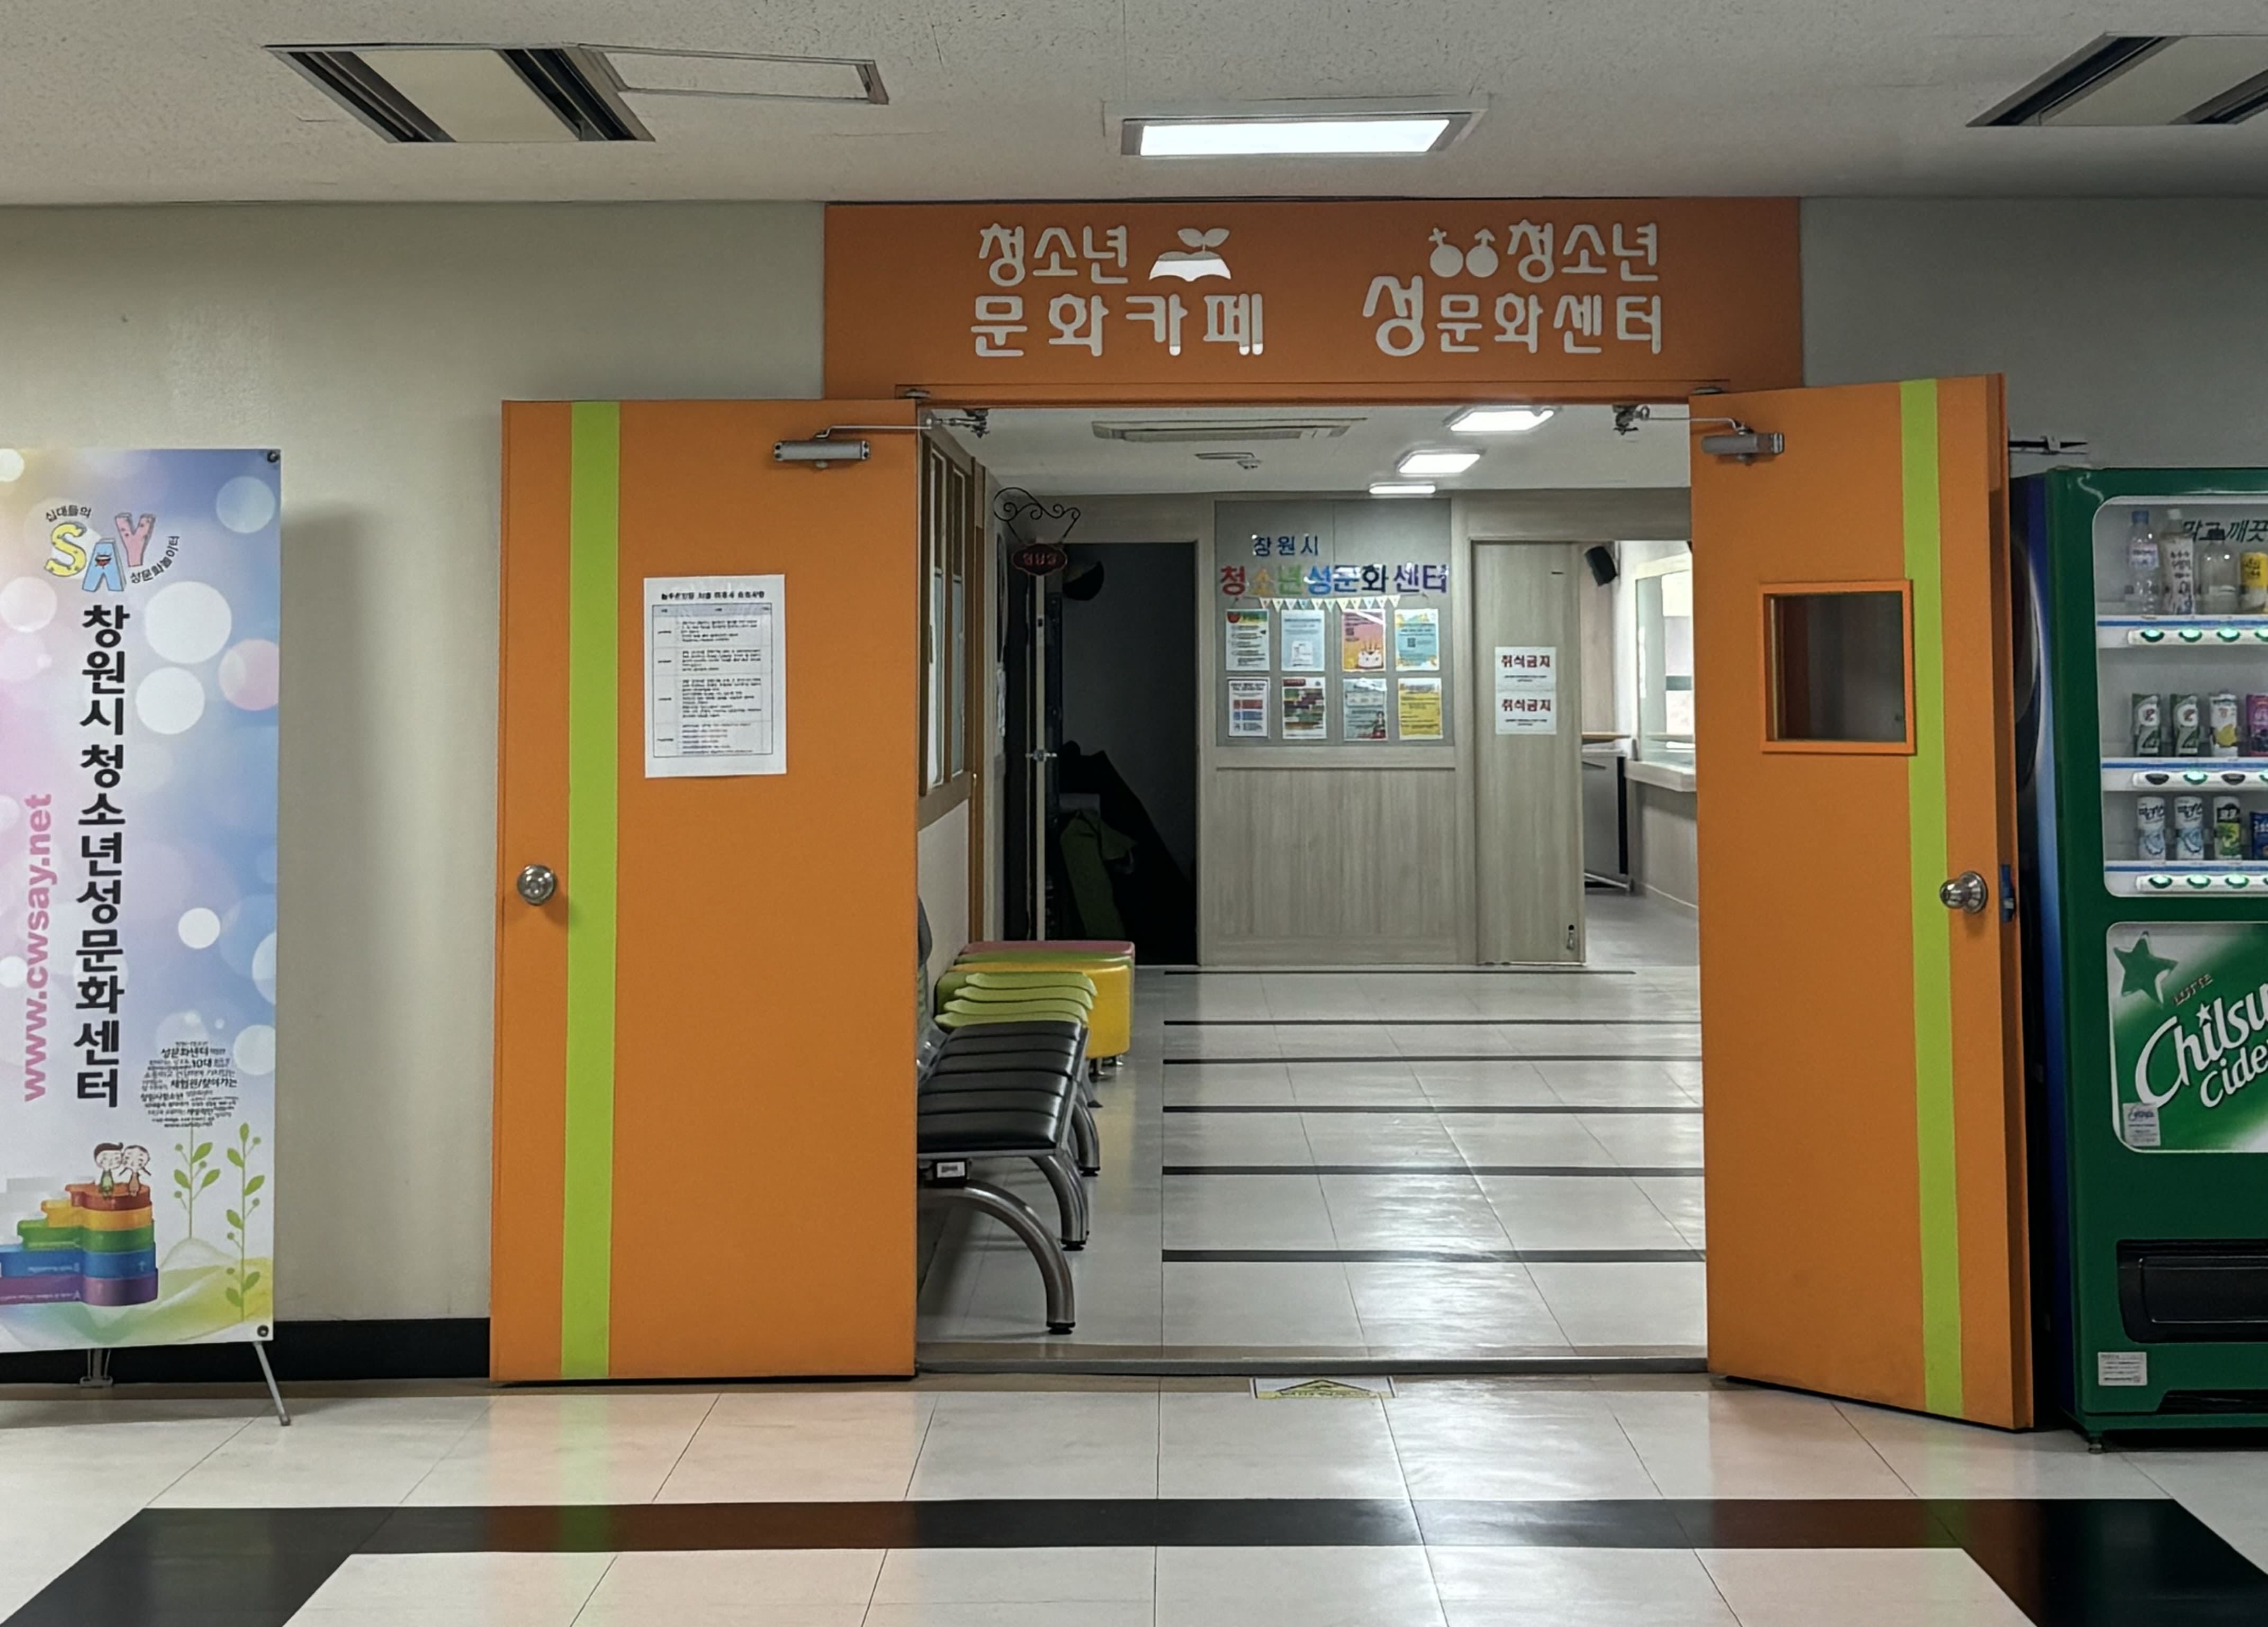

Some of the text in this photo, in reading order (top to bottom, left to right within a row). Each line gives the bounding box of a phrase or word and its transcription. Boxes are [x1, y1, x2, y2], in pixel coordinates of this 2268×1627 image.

[978, 222, 1129, 287] 청소년
[1507, 219, 1659, 284] 청소년
[970, 293, 1264, 357] 문화카페
[1362, 274, 1661, 357] 성문화센터
[44, 512, 157, 592] SAY
[1252, 535, 1319, 557] 창원시
[1501, 654, 1551, 668] 취식금지
[1501, 699, 1551, 712] 취식금지
[24, 794, 57, 1102] www.cwsay.net
[2200, 1039, 2268, 1107] Cide
